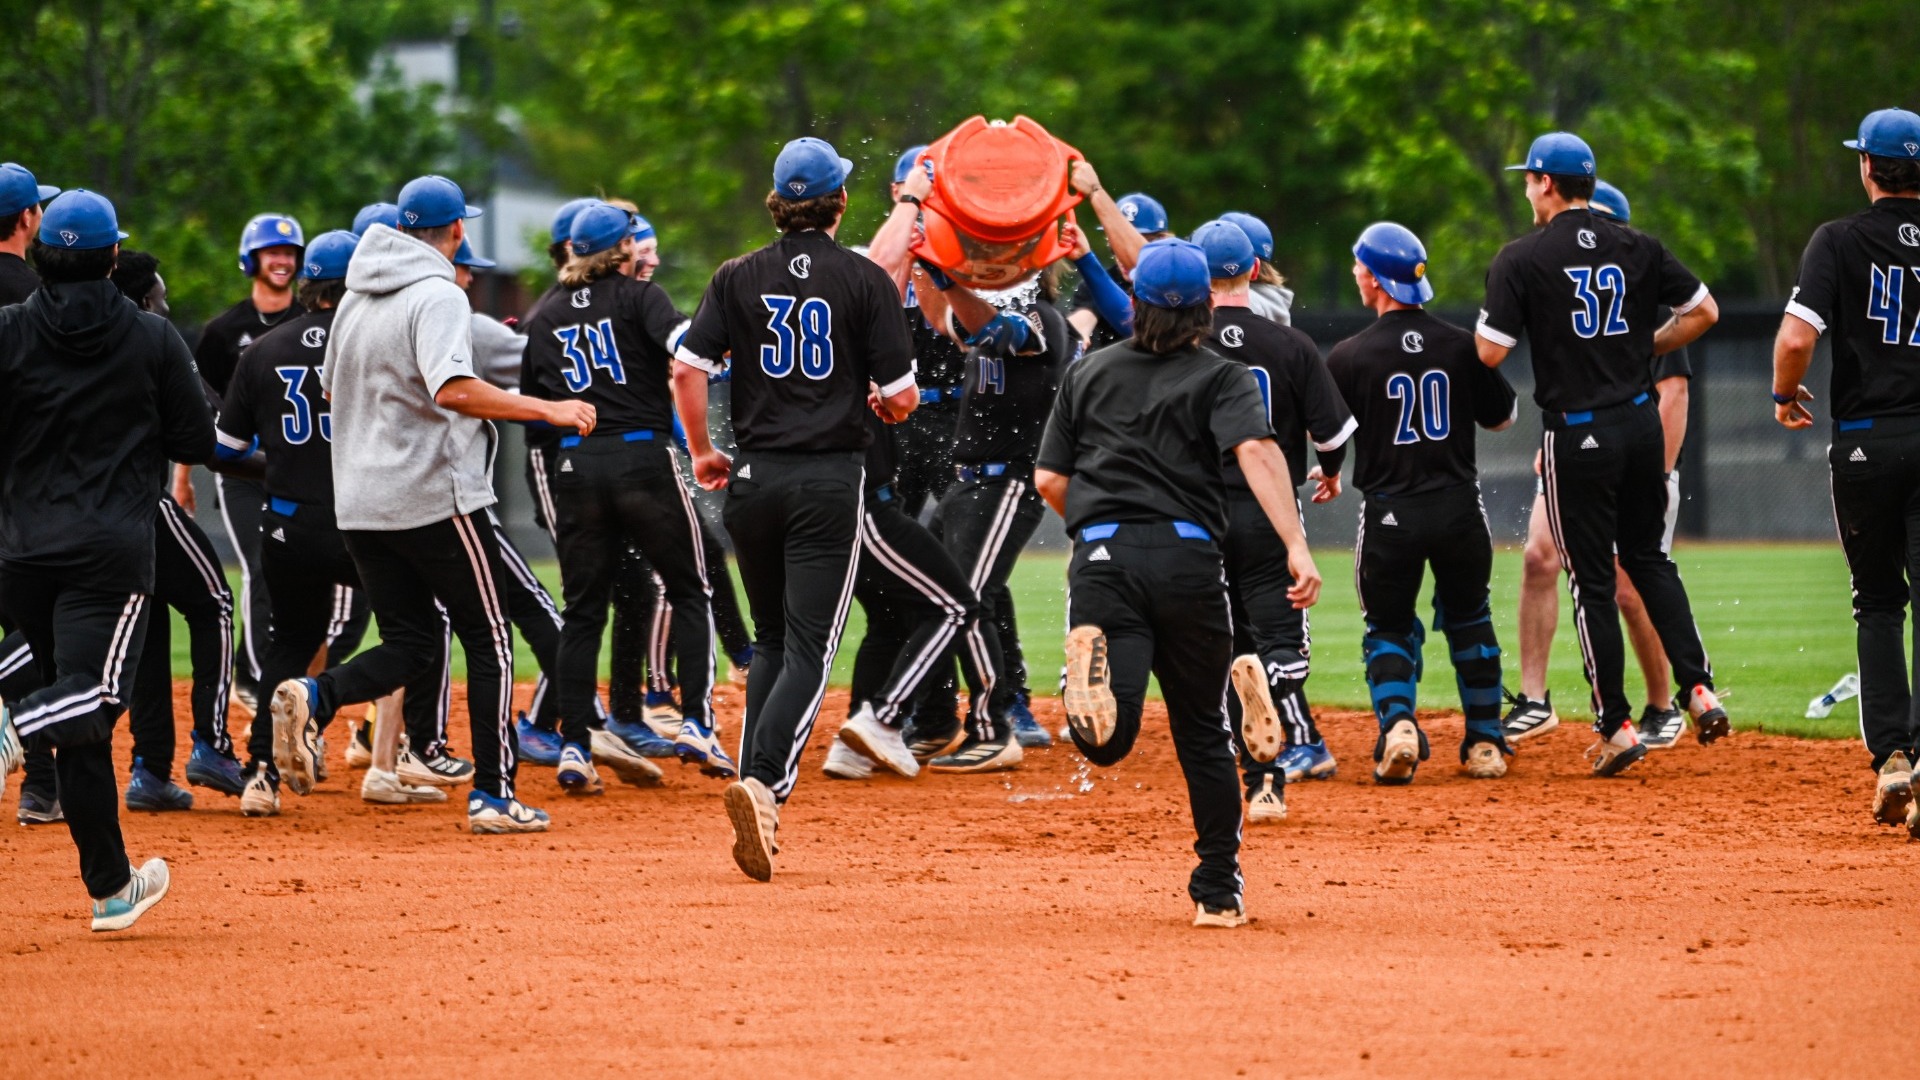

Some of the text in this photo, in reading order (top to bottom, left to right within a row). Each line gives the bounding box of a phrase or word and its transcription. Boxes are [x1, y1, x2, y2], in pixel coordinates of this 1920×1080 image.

[760, 294, 834, 380] 38
[1563, 265, 1630, 338] 32
[1866, 262, 1920, 347] 4
[552, 318, 627, 393] 34
[978, 356, 1005, 394] 14
[1386, 369, 1450, 445] 20
